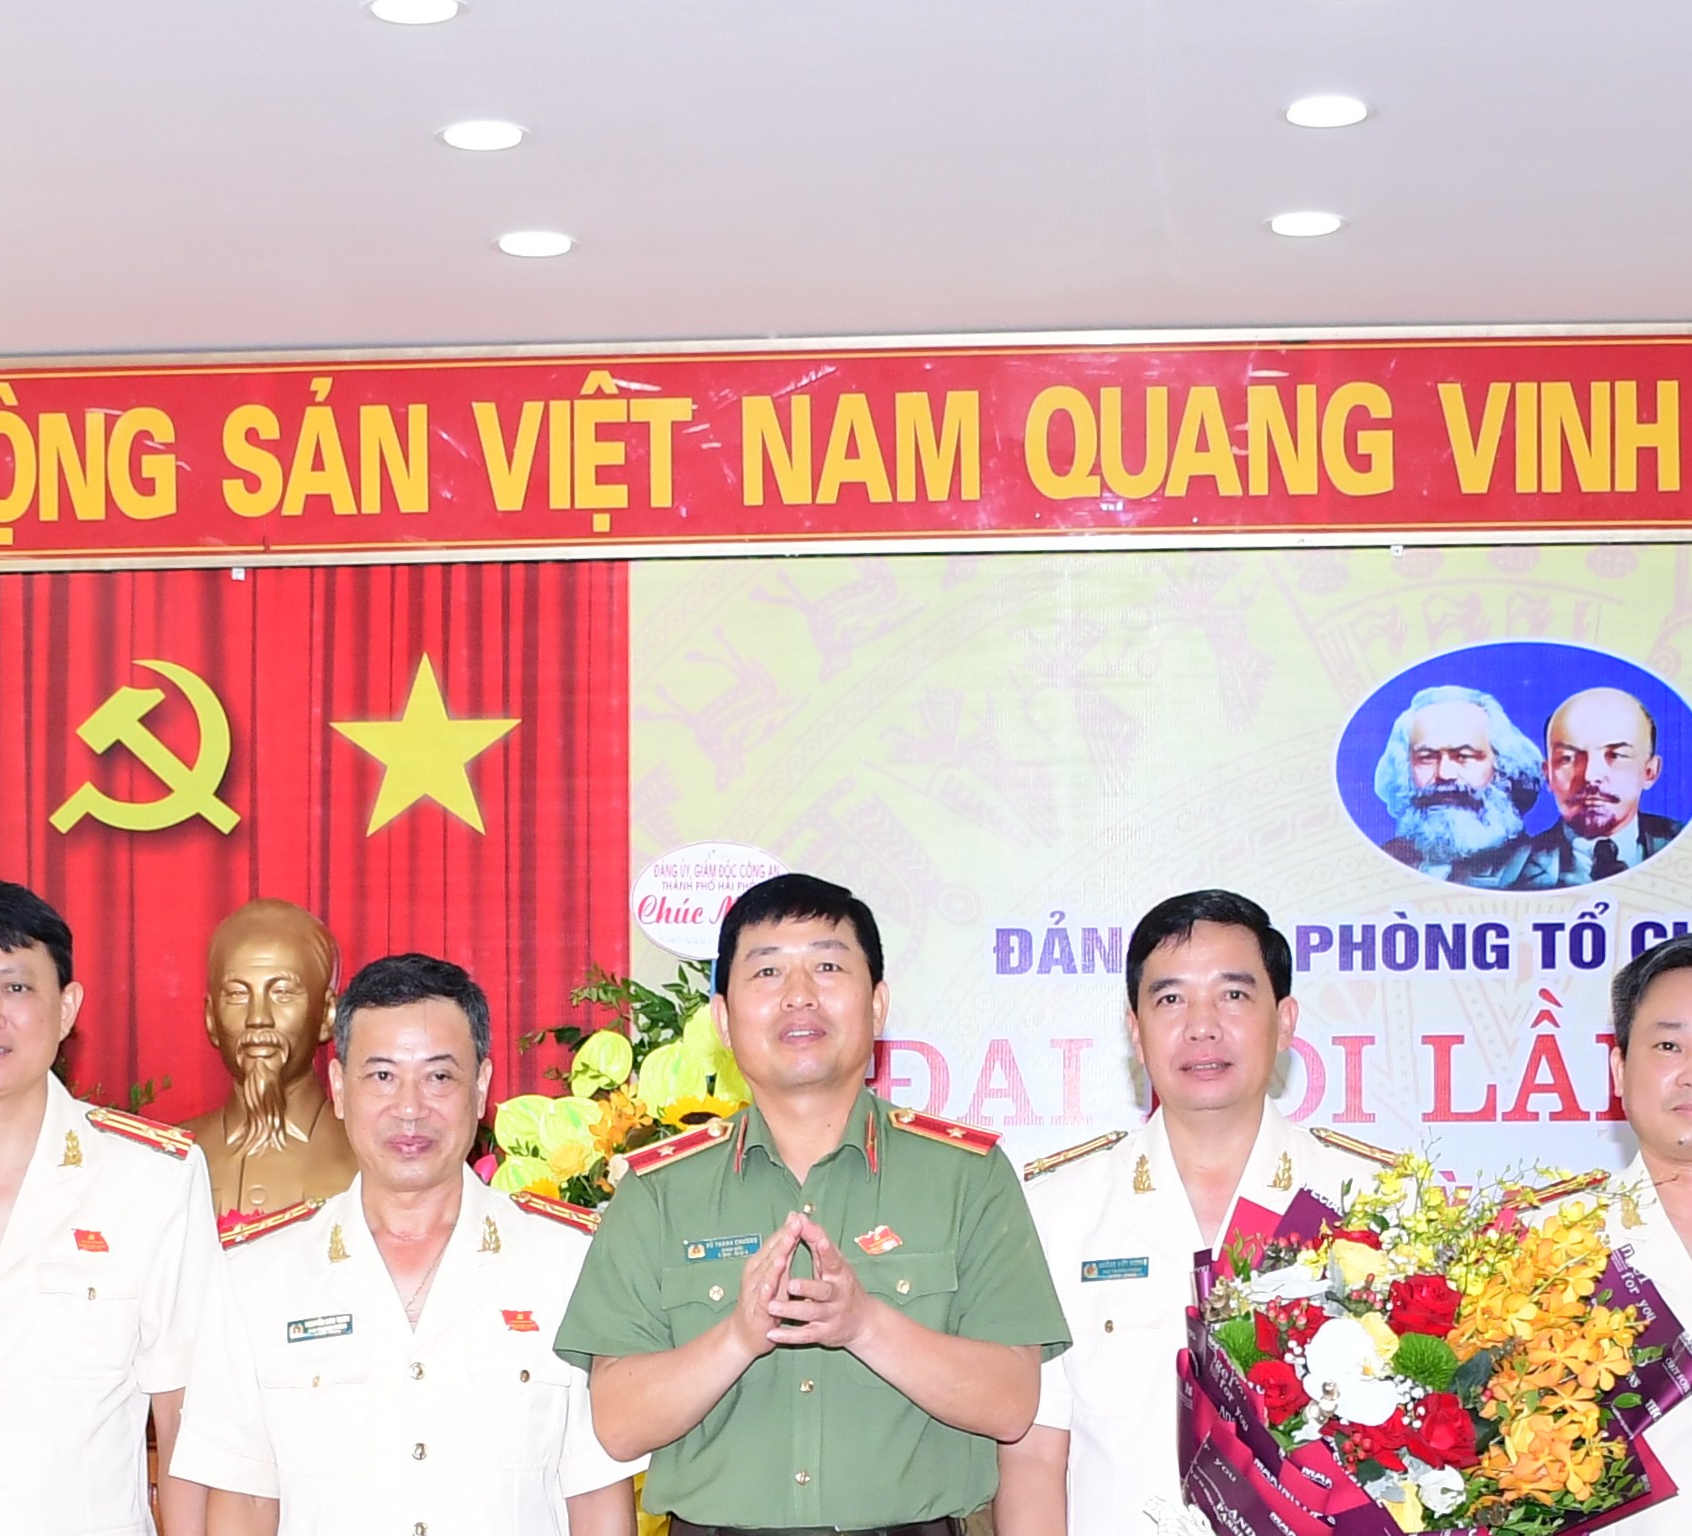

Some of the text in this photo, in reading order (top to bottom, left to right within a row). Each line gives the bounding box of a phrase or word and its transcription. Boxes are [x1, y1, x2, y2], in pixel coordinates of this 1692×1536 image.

[223, 377, 430, 518] SẢN
[473, 373, 693, 532] VIỆT
[742, 390, 980, 505] NAM
[1024, 381, 1393, 499] QUANG
[1439, 380, 1680, 493] VINH
[637, 894, 705, 925] Chúc
[993, 910, 1131, 975] ĐẢN
[1295, 910, 1510, 973] PHÒNG
[1531, 901, 1610, 971] TỔ
[1213, 1457, 1238, 1484] you
